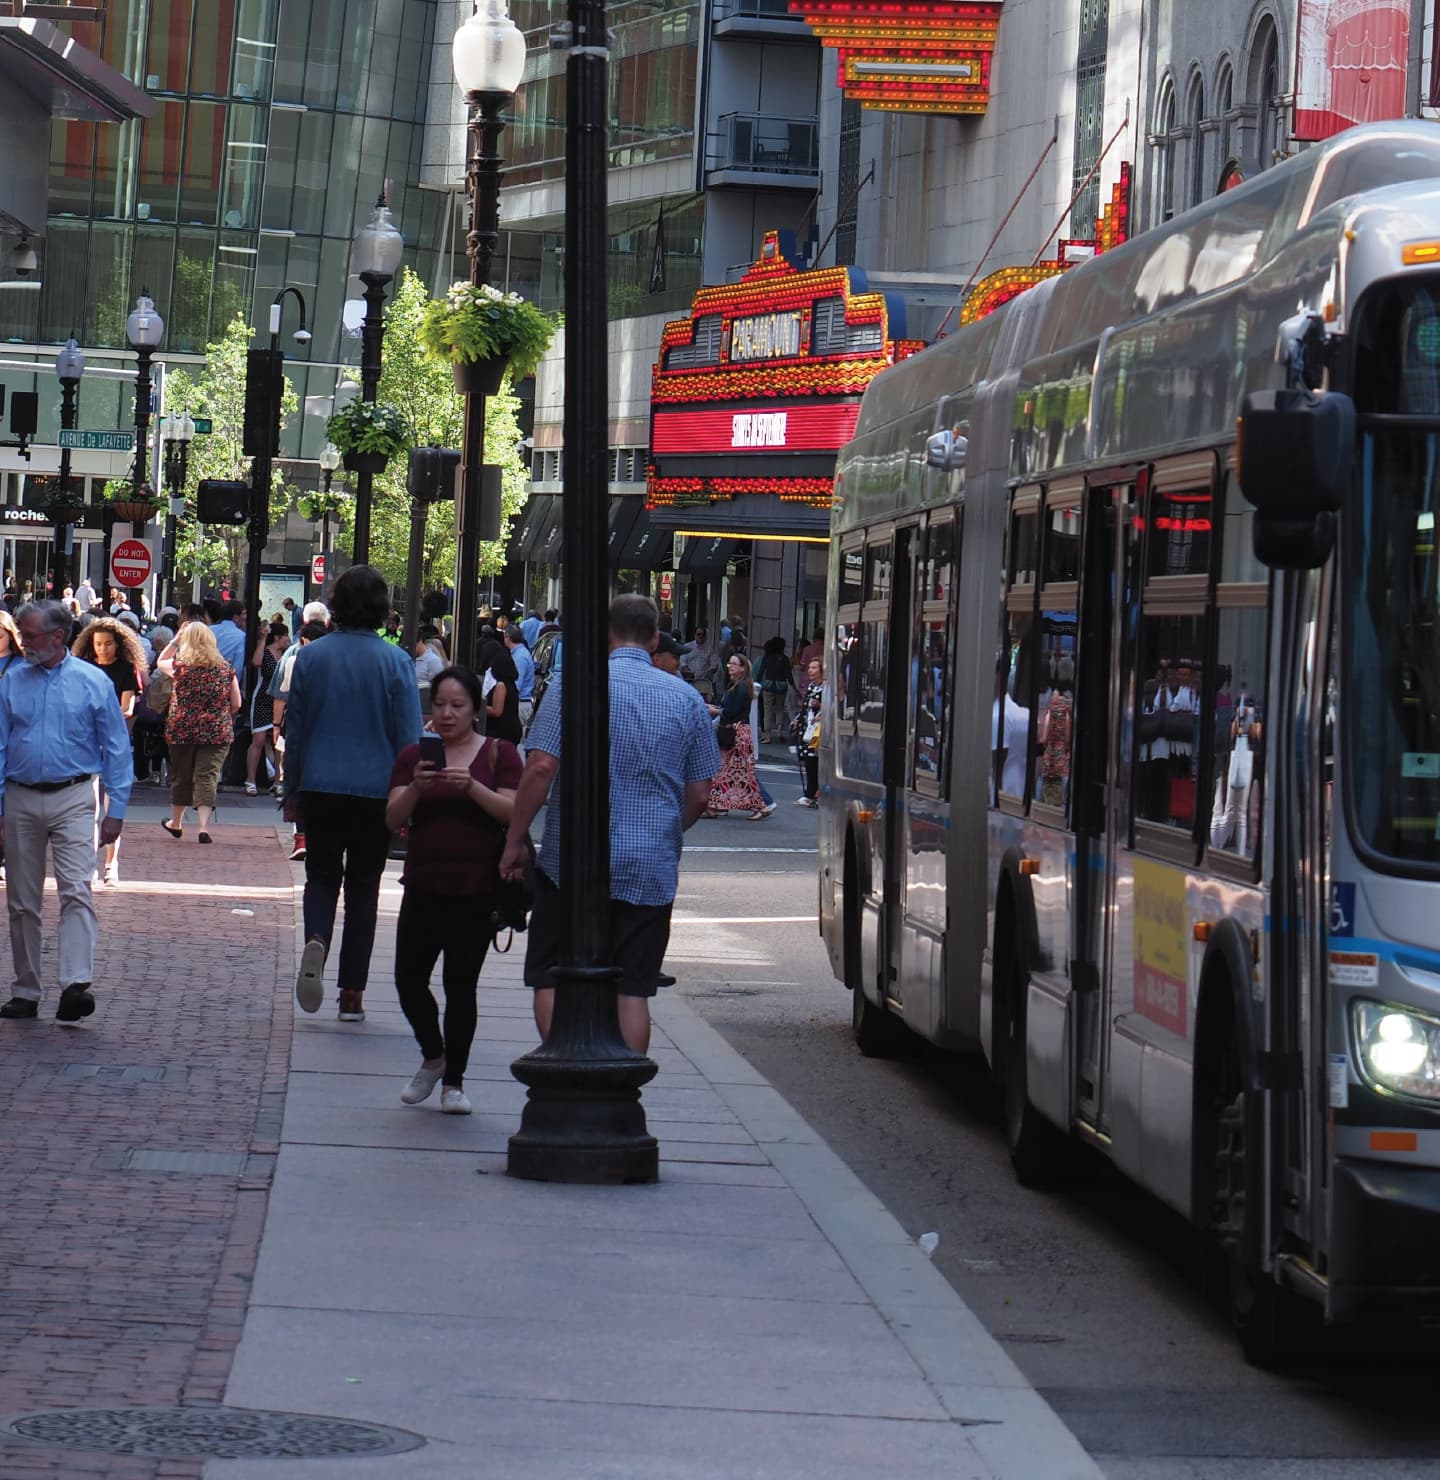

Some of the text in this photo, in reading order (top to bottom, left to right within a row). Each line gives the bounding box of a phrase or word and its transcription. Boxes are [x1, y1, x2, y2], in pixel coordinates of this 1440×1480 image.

[731, 312, 801, 361] PARAMOUNT
[60, 432, 85, 447] AVENUE
[98, 434, 131, 449] LAFAYETTE
[131, 550, 145, 558] NOT
[120, 570, 142, 578] ENTER
